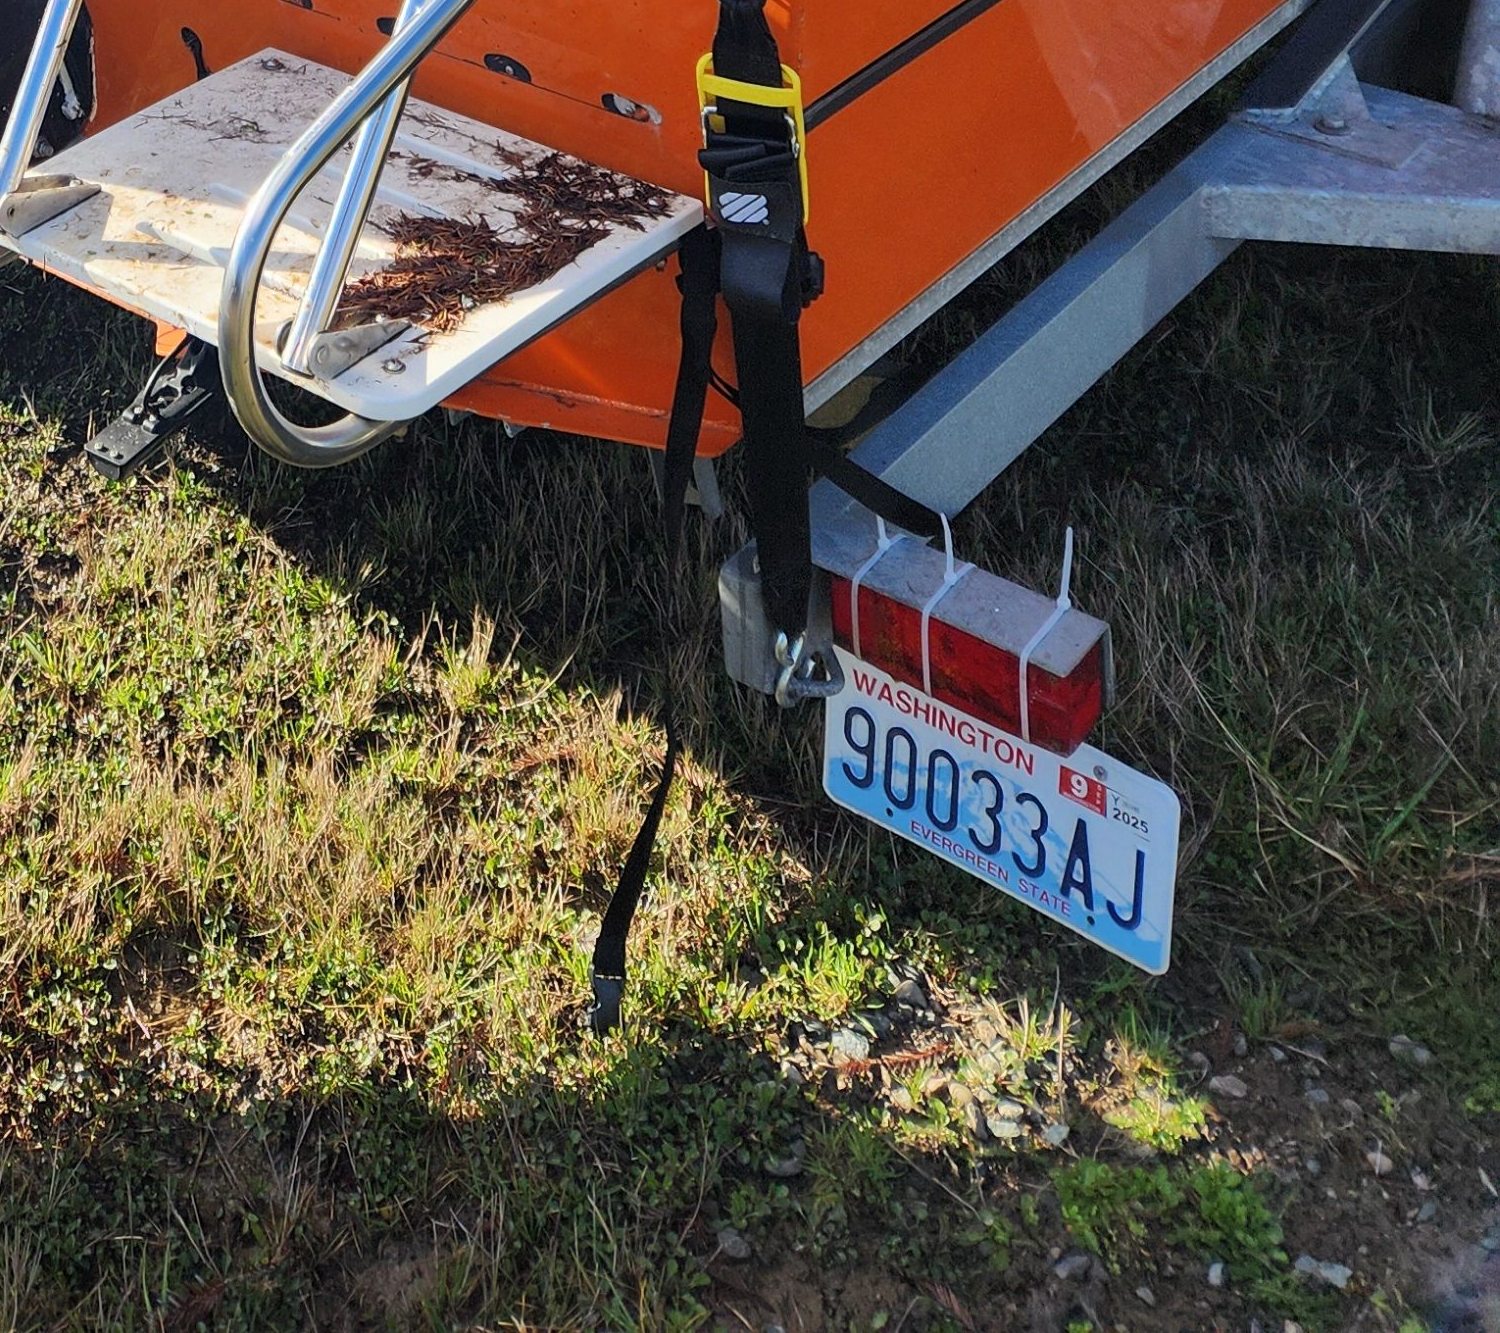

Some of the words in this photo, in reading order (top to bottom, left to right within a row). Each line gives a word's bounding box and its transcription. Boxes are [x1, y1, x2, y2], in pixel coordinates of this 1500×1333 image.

[853, 668, 1035, 776] WASHINGTON
[842, 706, 1145, 932] 90033AJ
[1070, 774, 1088, 799] 9
[1113, 808, 1149, 834] 2025
[910, 820, 1009, 883] EVERGREEN
[1018, 877, 1072, 919] STATE
